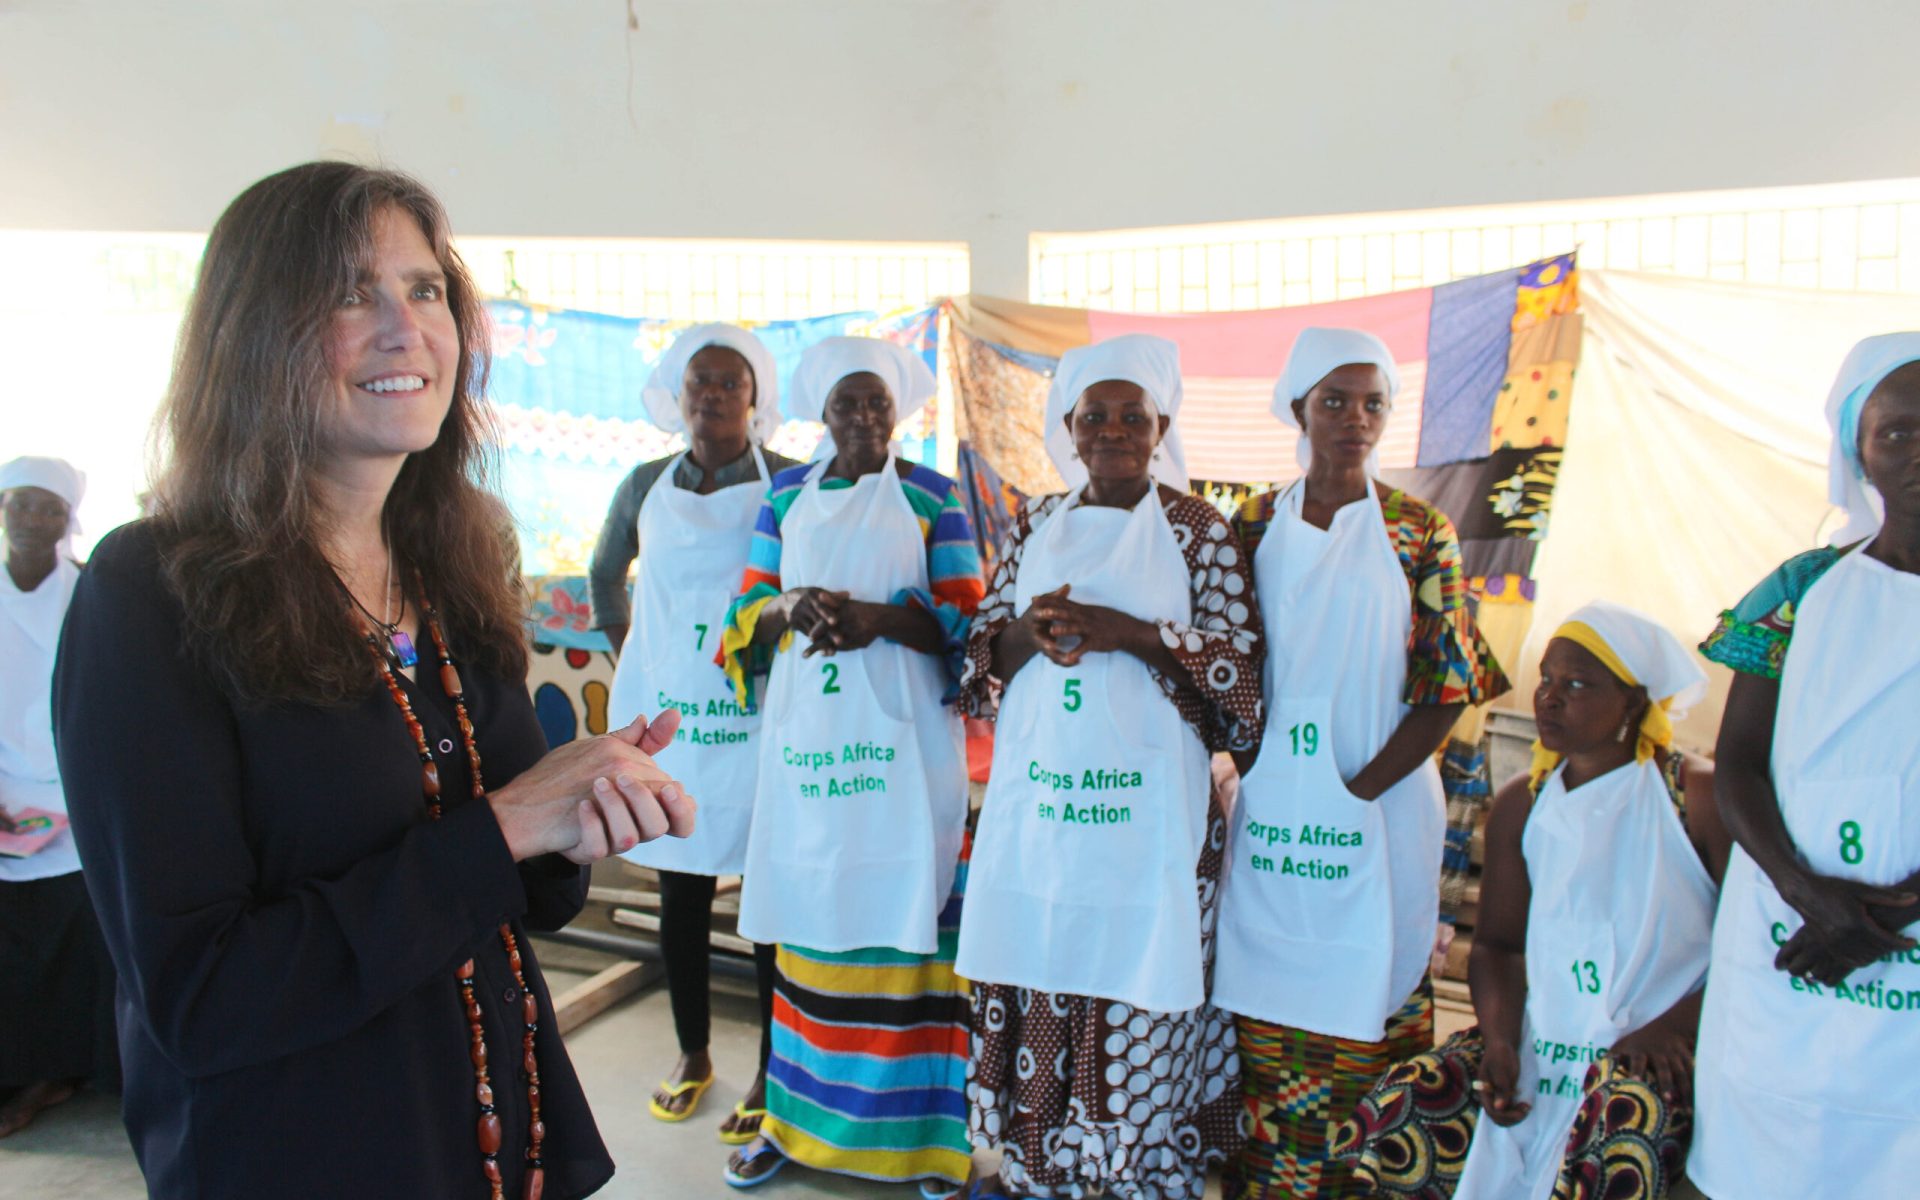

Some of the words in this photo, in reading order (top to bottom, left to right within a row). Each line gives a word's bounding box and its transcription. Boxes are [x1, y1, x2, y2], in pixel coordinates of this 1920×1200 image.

[694, 624, 709, 652] 7
[821, 662, 841, 695] 2
[1062, 678, 1083, 713] 5
[690, 726, 749, 746] Action
[1288, 722, 1319, 757] 19
[782, 745, 836, 771] Corps
[841, 743, 896, 765] Africa
[799, 783, 821, 799] en
[827, 774, 887, 798] Action
[1028, 760, 1074, 792] Corps
[1080, 767, 1143, 791] Africa
[1037, 801, 1056, 820] en
[1061, 801, 1132, 825] Action
[1298, 823, 1363, 847] Africa
[1838, 820, 1864, 865] 8
[1250, 853, 1275, 872] en
[1280, 855, 1350, 880] Action
[1571, 959, 1601, 996] 13
